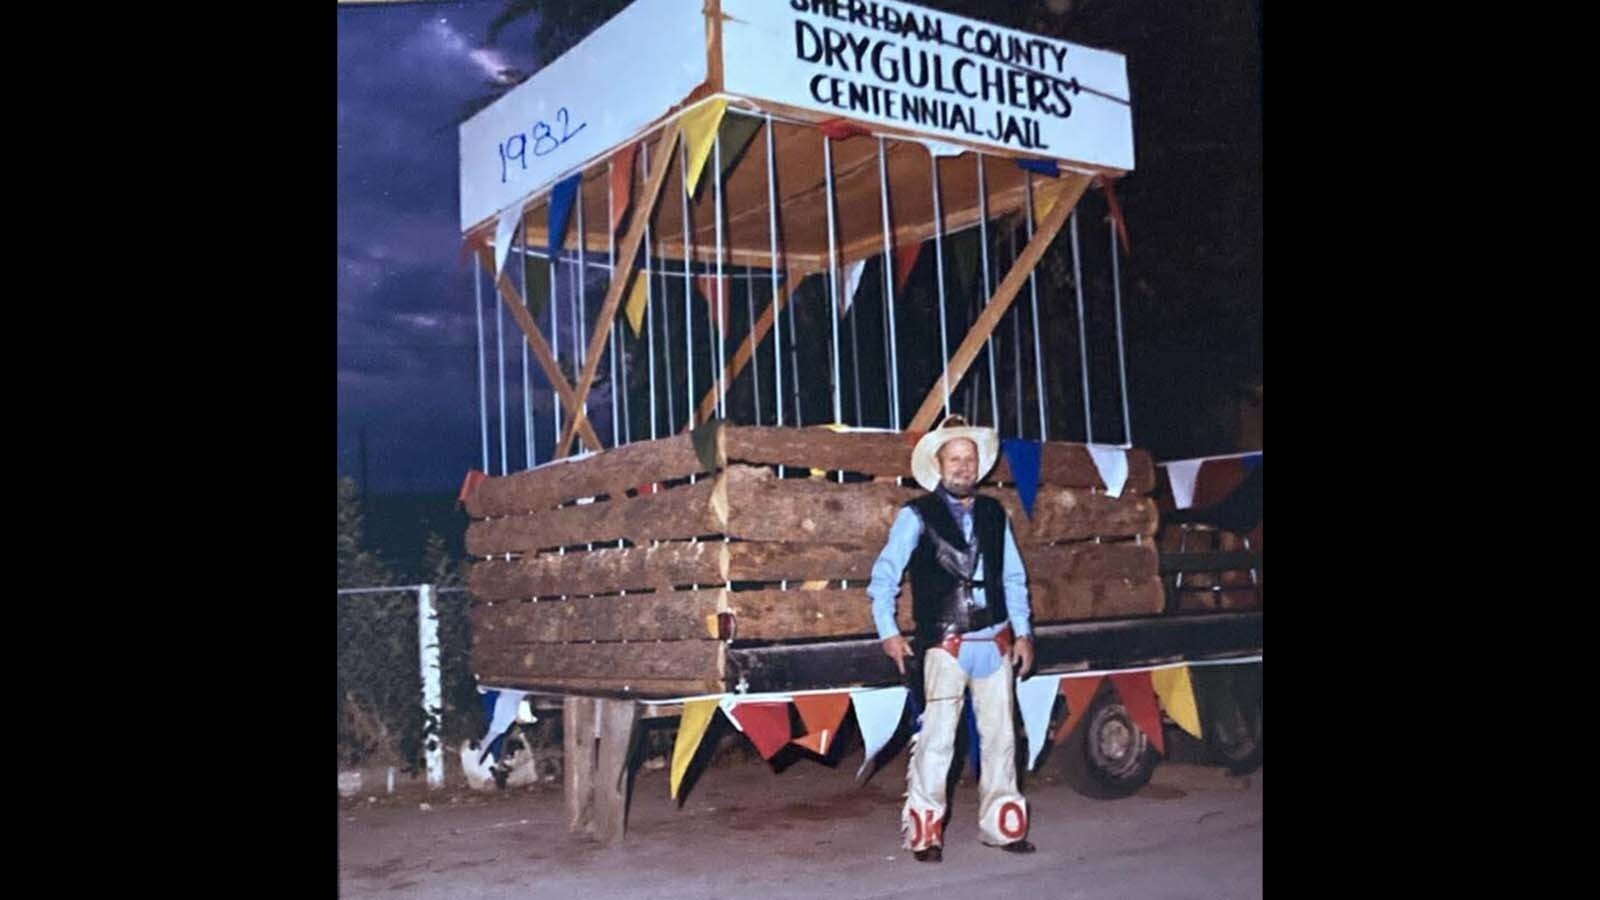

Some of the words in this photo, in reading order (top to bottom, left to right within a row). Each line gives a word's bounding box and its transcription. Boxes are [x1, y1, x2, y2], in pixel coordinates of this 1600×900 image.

[957, 24, 1067, 72] COUNTY
[499, 107, 587, 183] 1982
[810, 74, 984, 136] CENTENNIAL
[987, 110, 1049, 149] JAIL
